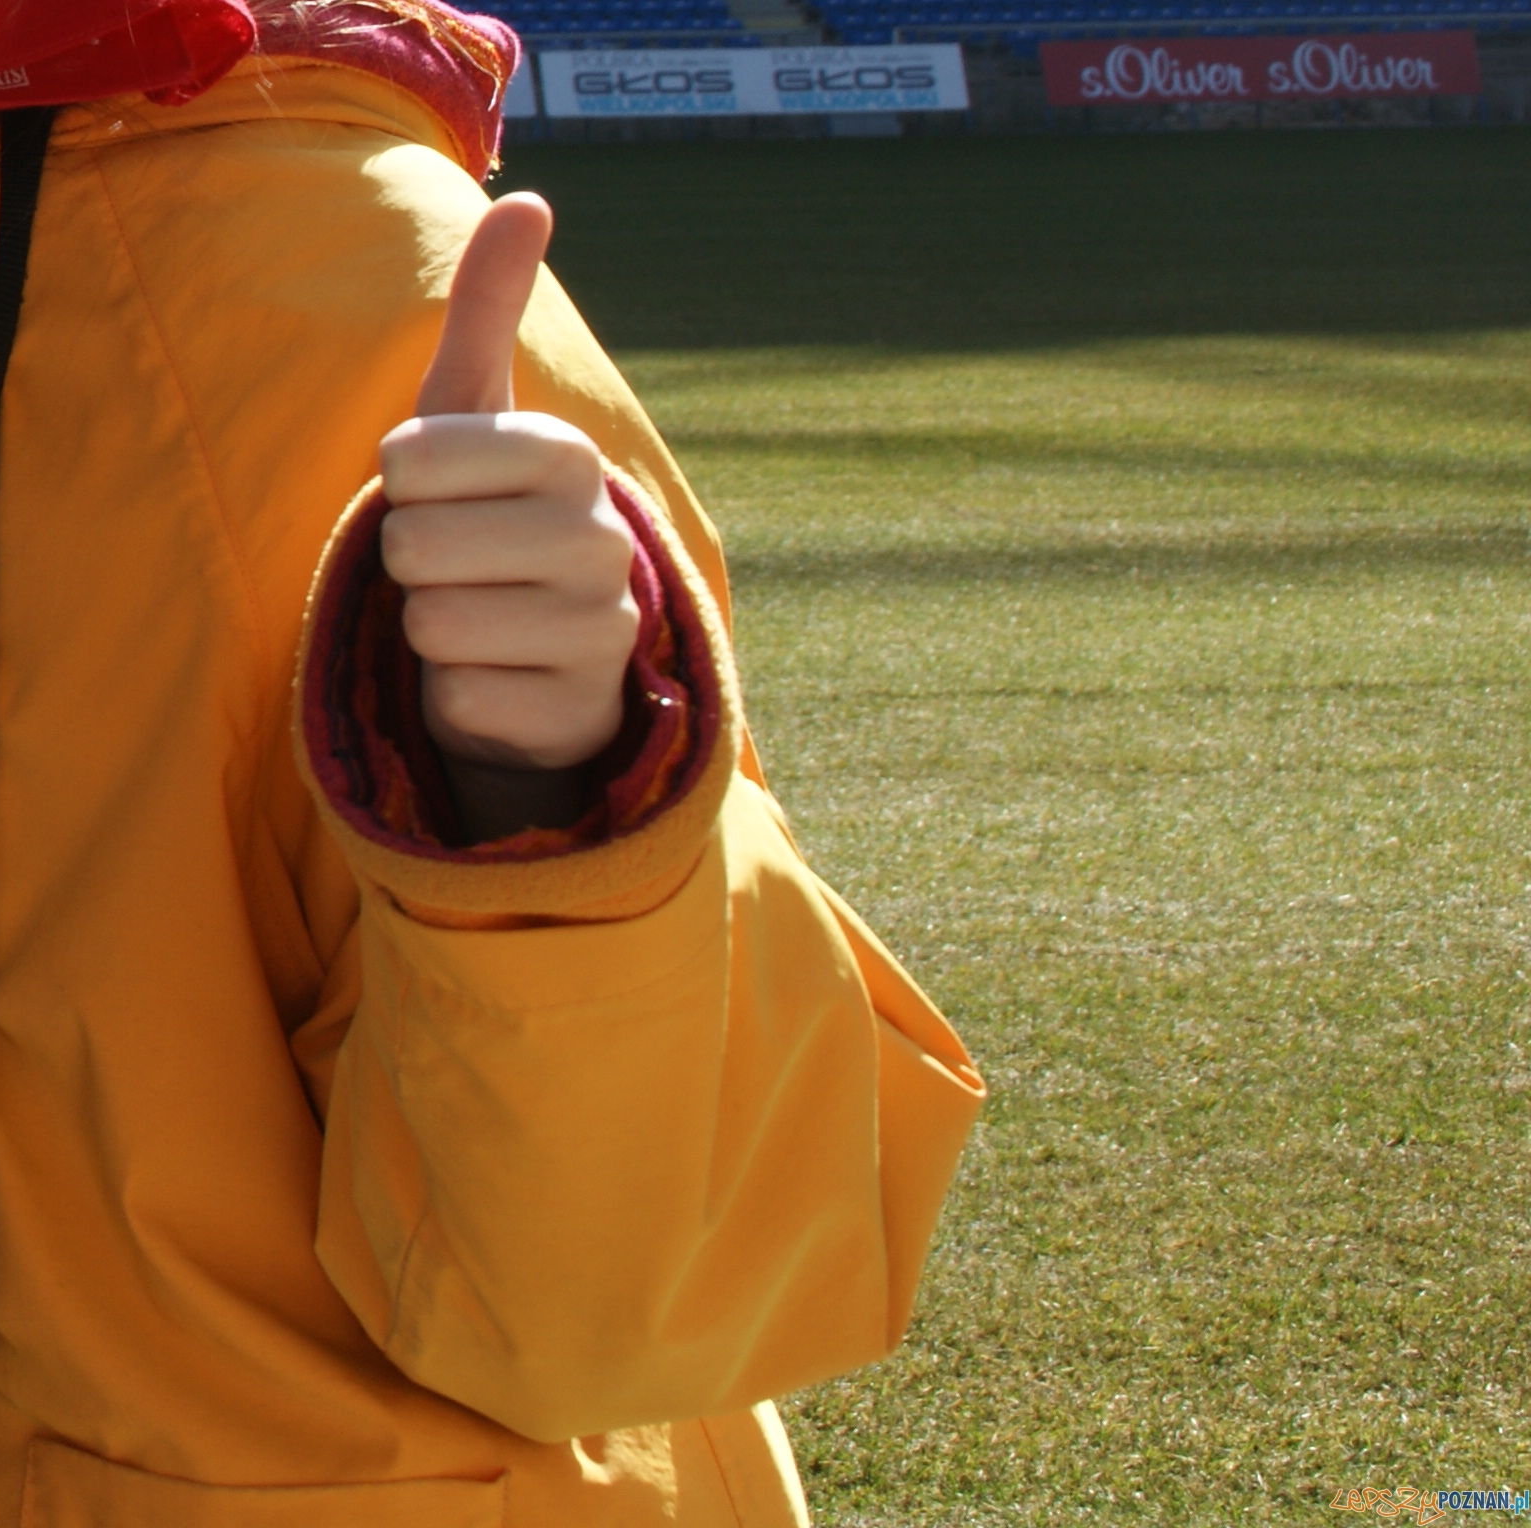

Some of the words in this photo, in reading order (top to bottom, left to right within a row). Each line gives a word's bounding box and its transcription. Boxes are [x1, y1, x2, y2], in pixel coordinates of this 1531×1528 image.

[572, 69, 735, 95] GŁOS
[772, 64, 937, 93] GŁOS
[1079, 43, 1249, 99] s.Oliver
[1267, 38, 1440, 94] s.Oliver
